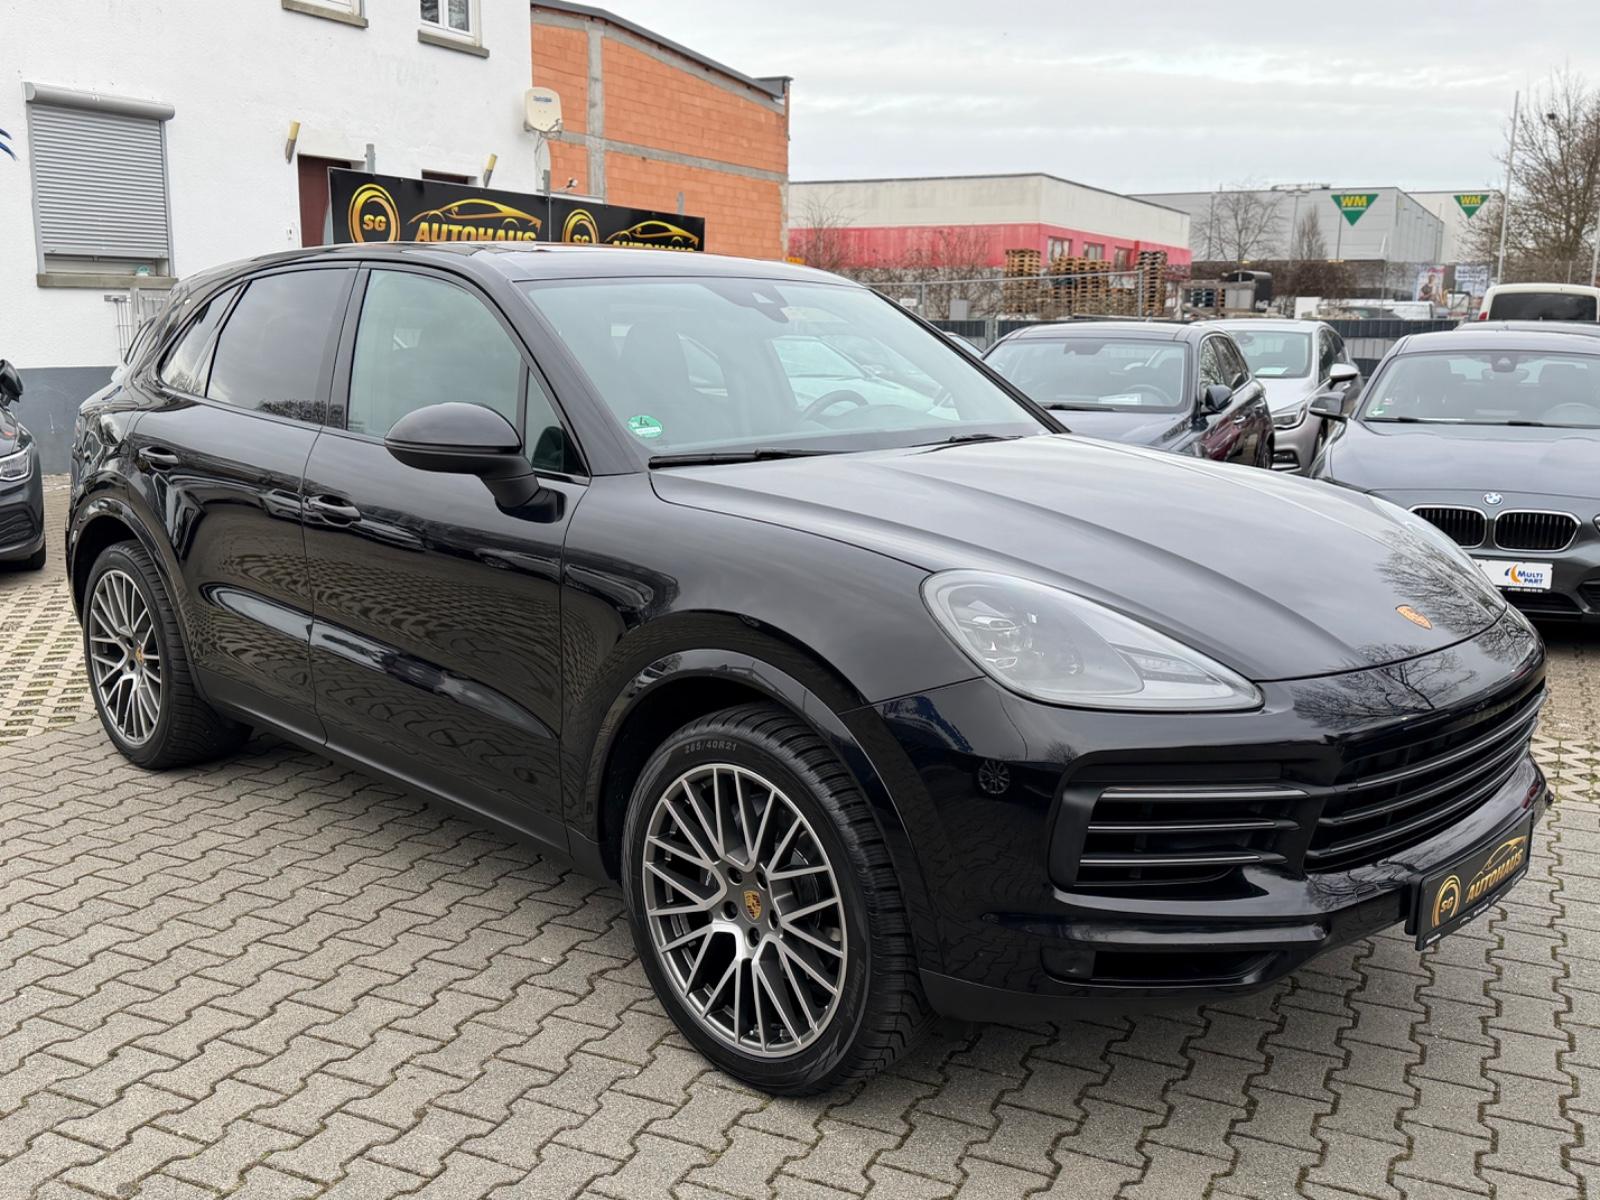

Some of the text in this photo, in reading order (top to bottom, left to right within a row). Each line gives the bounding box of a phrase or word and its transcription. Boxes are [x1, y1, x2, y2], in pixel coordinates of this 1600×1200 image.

[1340, 195, 1367, 207] WM
[1461, 195, 1481, 206] WM
[362, 214, 387, 231] SG
